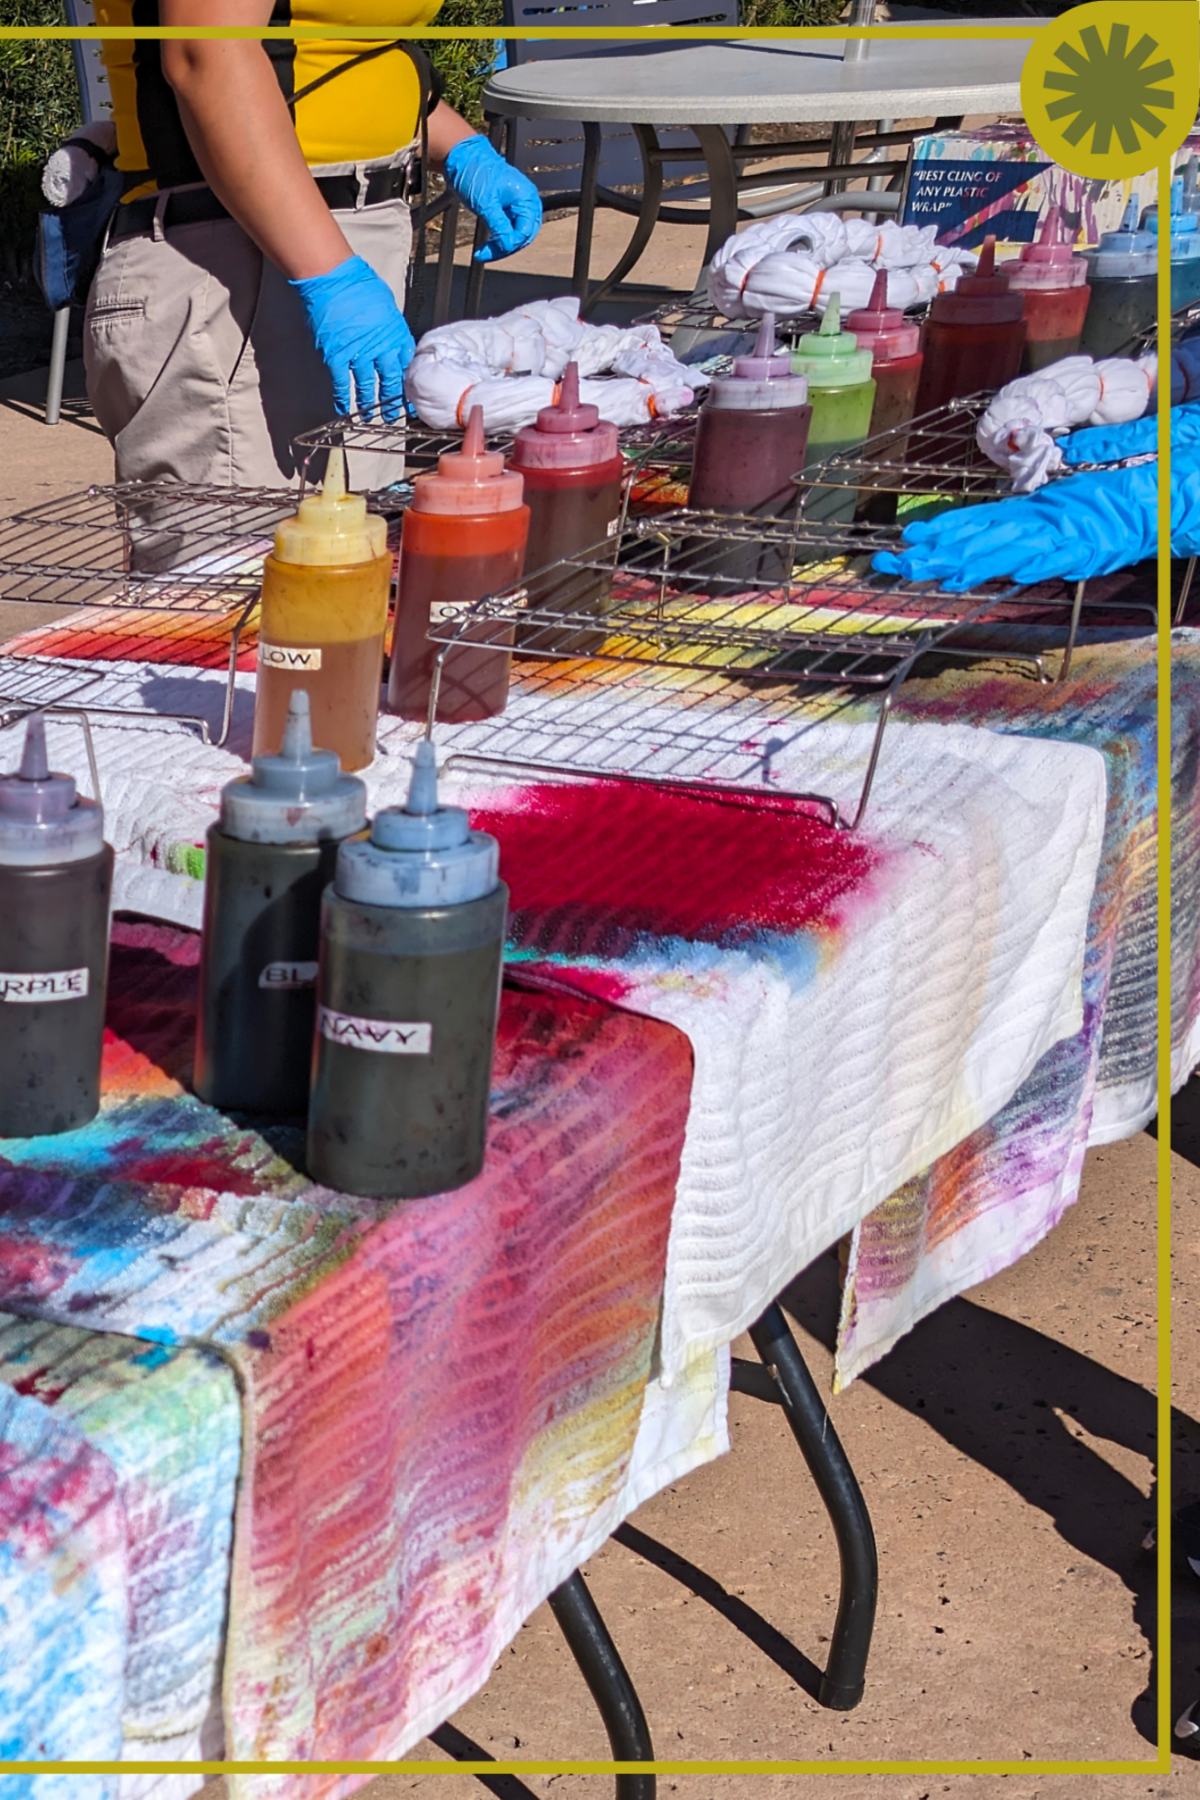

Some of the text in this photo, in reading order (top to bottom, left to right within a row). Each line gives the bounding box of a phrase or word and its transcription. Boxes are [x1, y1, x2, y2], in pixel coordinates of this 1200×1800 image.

[946, 170, 983, 182] CLING
[984, 171, 1002, 183] OF
[915, 185, 989, 198] ANY PLASTIC
[320, 1012, 418, 1046] NAVY
